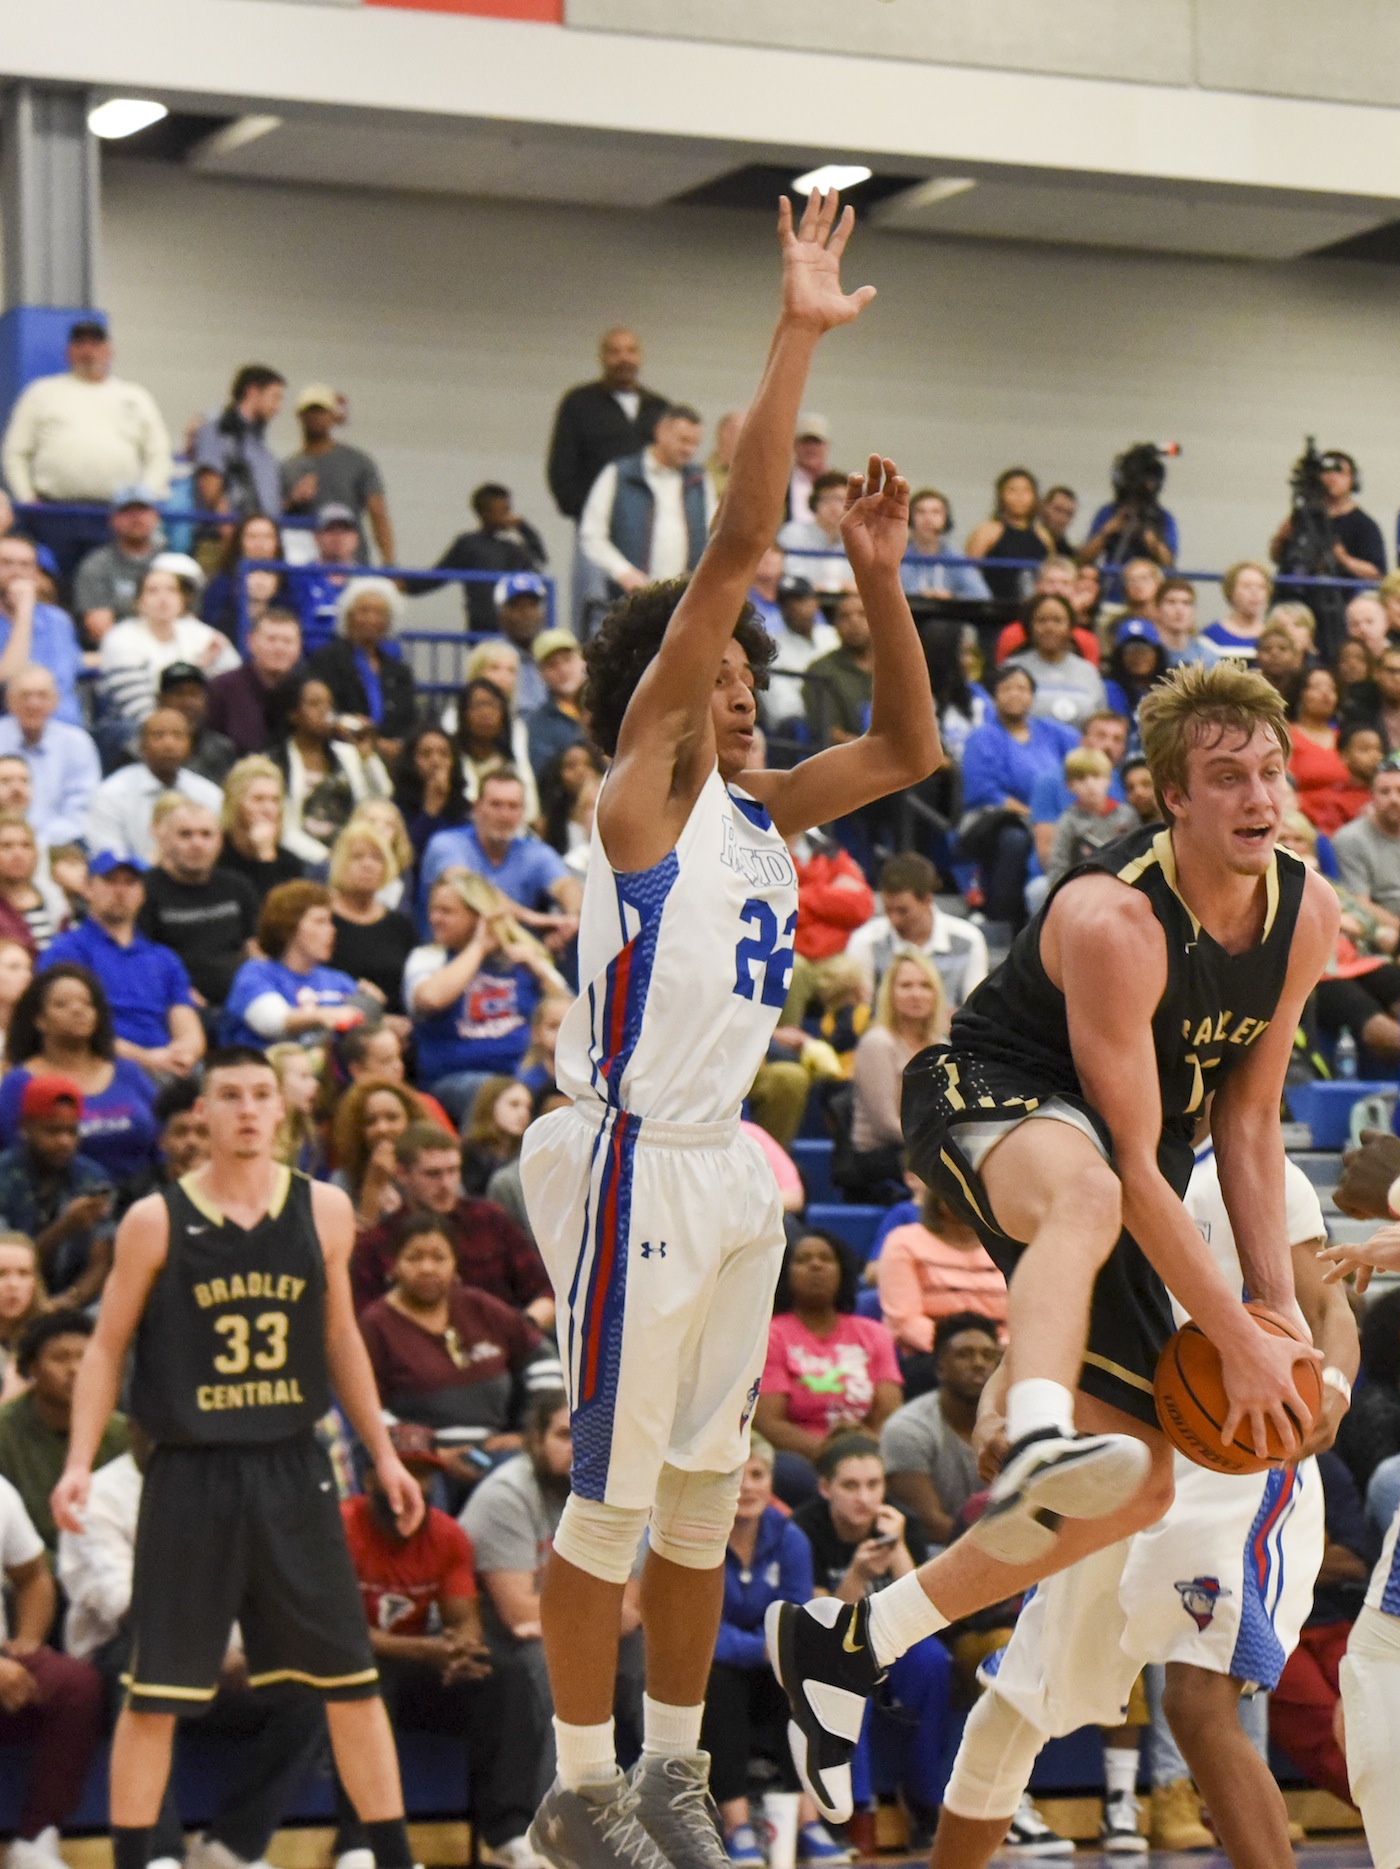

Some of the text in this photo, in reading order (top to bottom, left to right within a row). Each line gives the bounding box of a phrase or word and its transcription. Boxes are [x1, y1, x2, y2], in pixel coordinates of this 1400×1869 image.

[732, 898, 799, 1009] 22
[194, 1271, 306, 1308] BRADLEY
[213, 1311, 289, 1374] 33
[197, 1377, 304, 1411] CENTRAL
